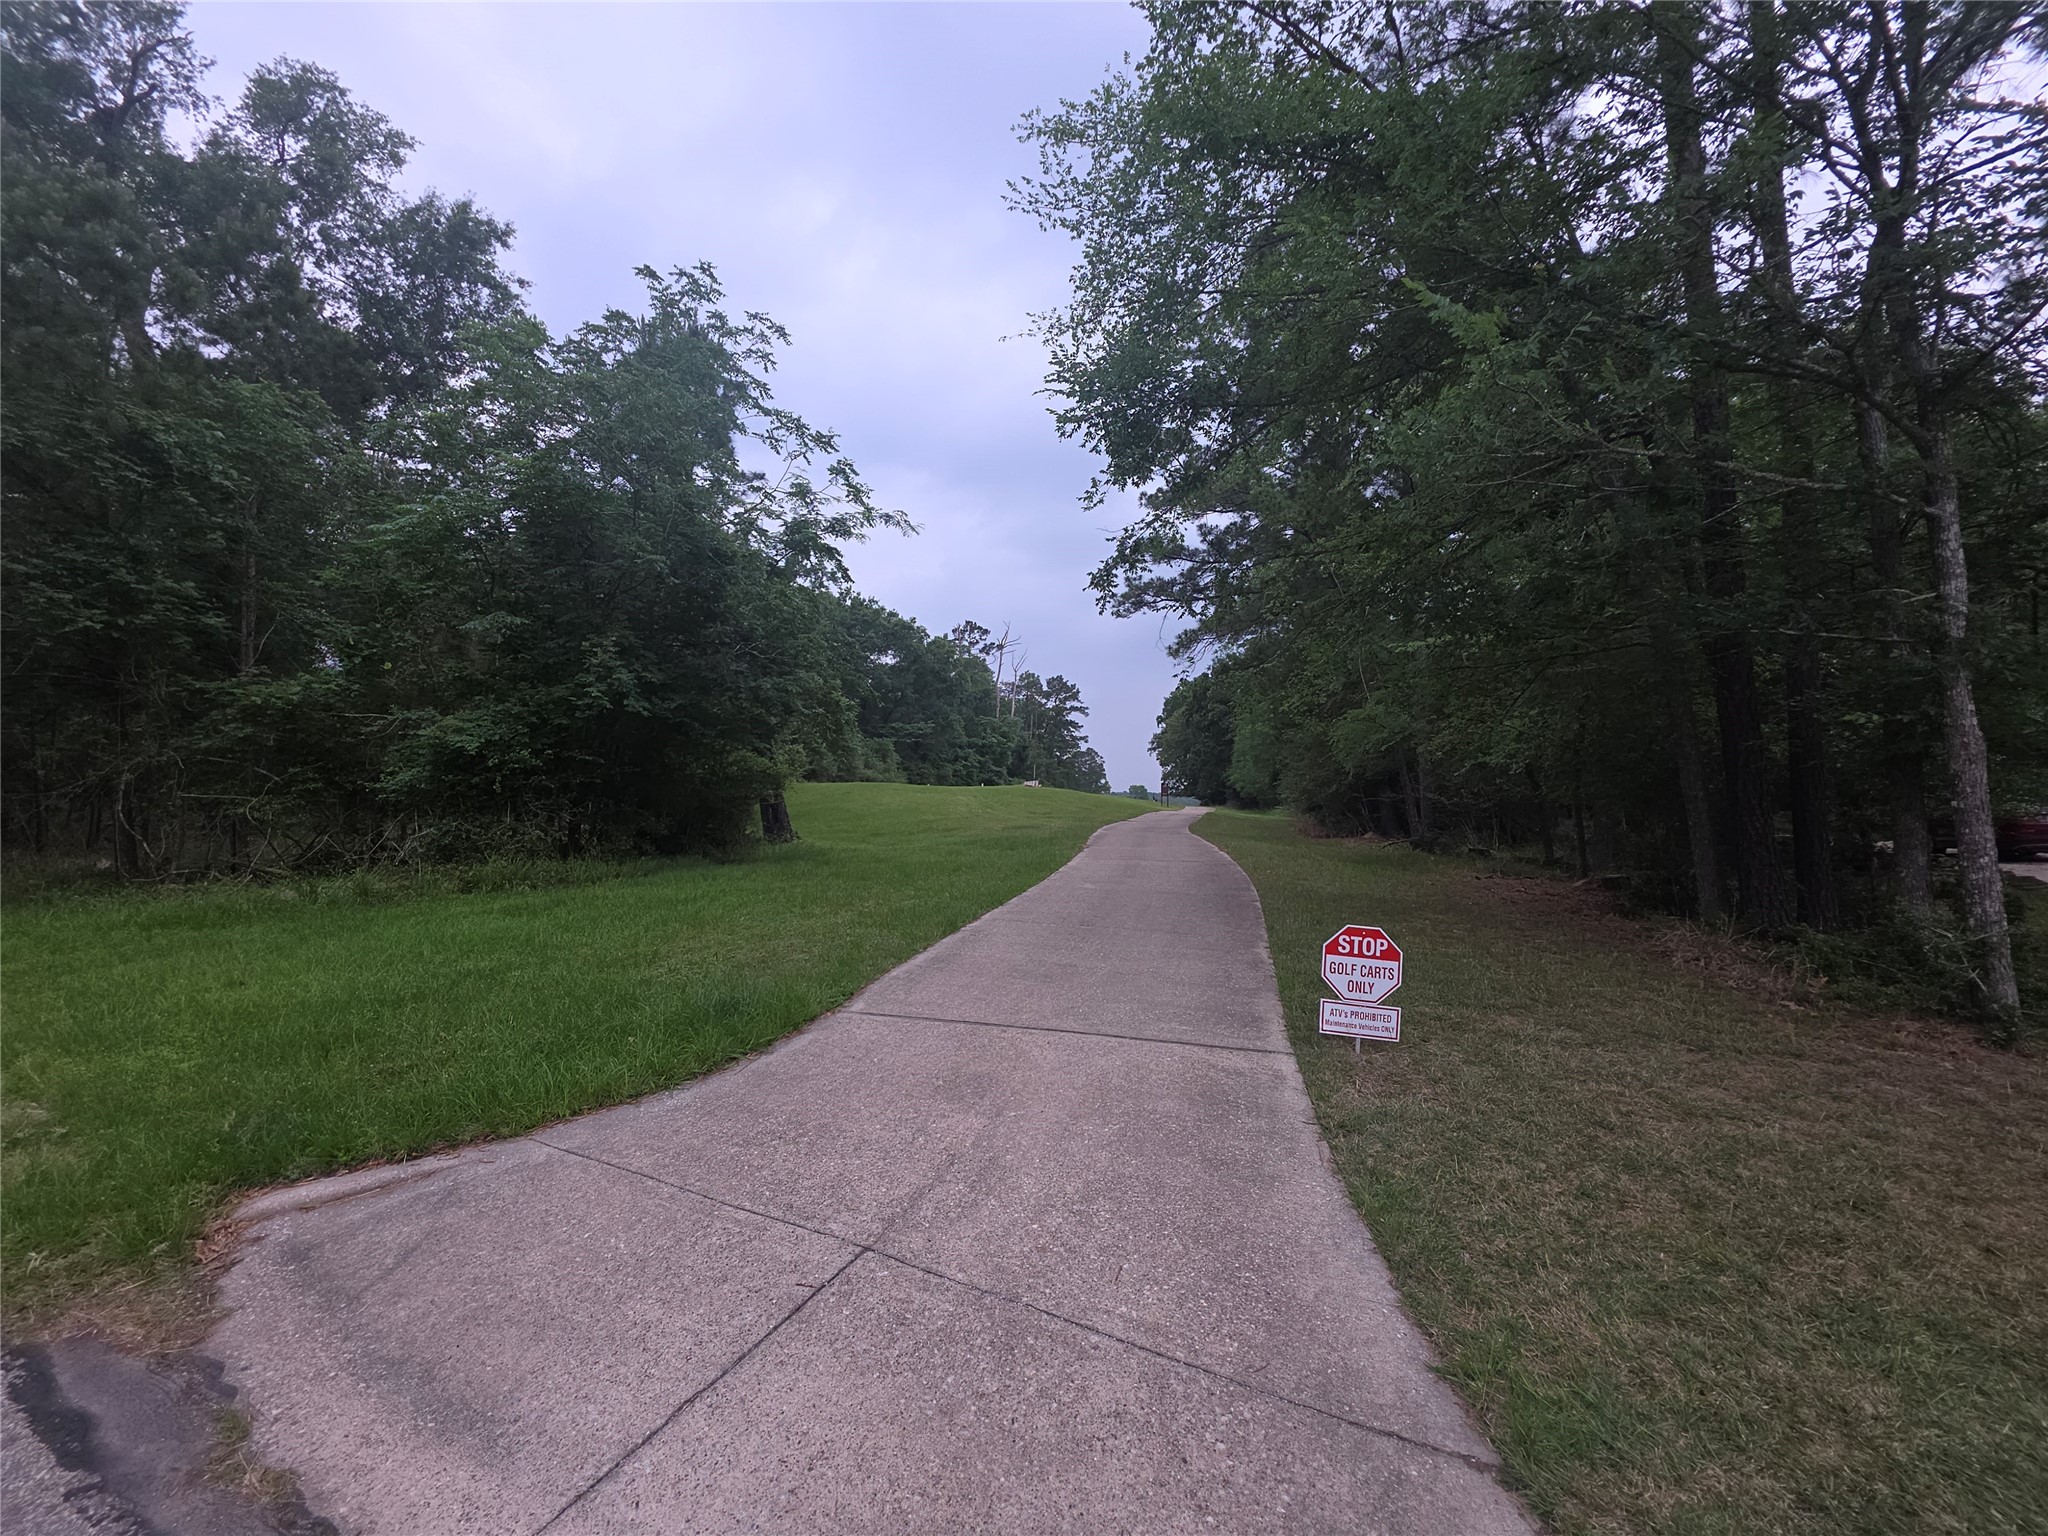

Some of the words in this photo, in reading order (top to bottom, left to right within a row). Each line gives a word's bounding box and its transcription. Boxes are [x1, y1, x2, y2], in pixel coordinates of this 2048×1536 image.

[1338, 934, 1388, 957] STOP
[1329, 961, 1357, 976] GOLF
[1360, 964, 1395, 981] CARTS
[1347, 979, 1375, 995] ONLY
[1329, 1008, 1348, 1019] ATV's
[1350, 1010, 1392, 1023] PROHIBITED
[1324, 1019, 1357, 1030] Maintenance
[1358, 1023, 1380, 1033] Vehicles
[1380, 1025, 1395, 1034] ONLY
